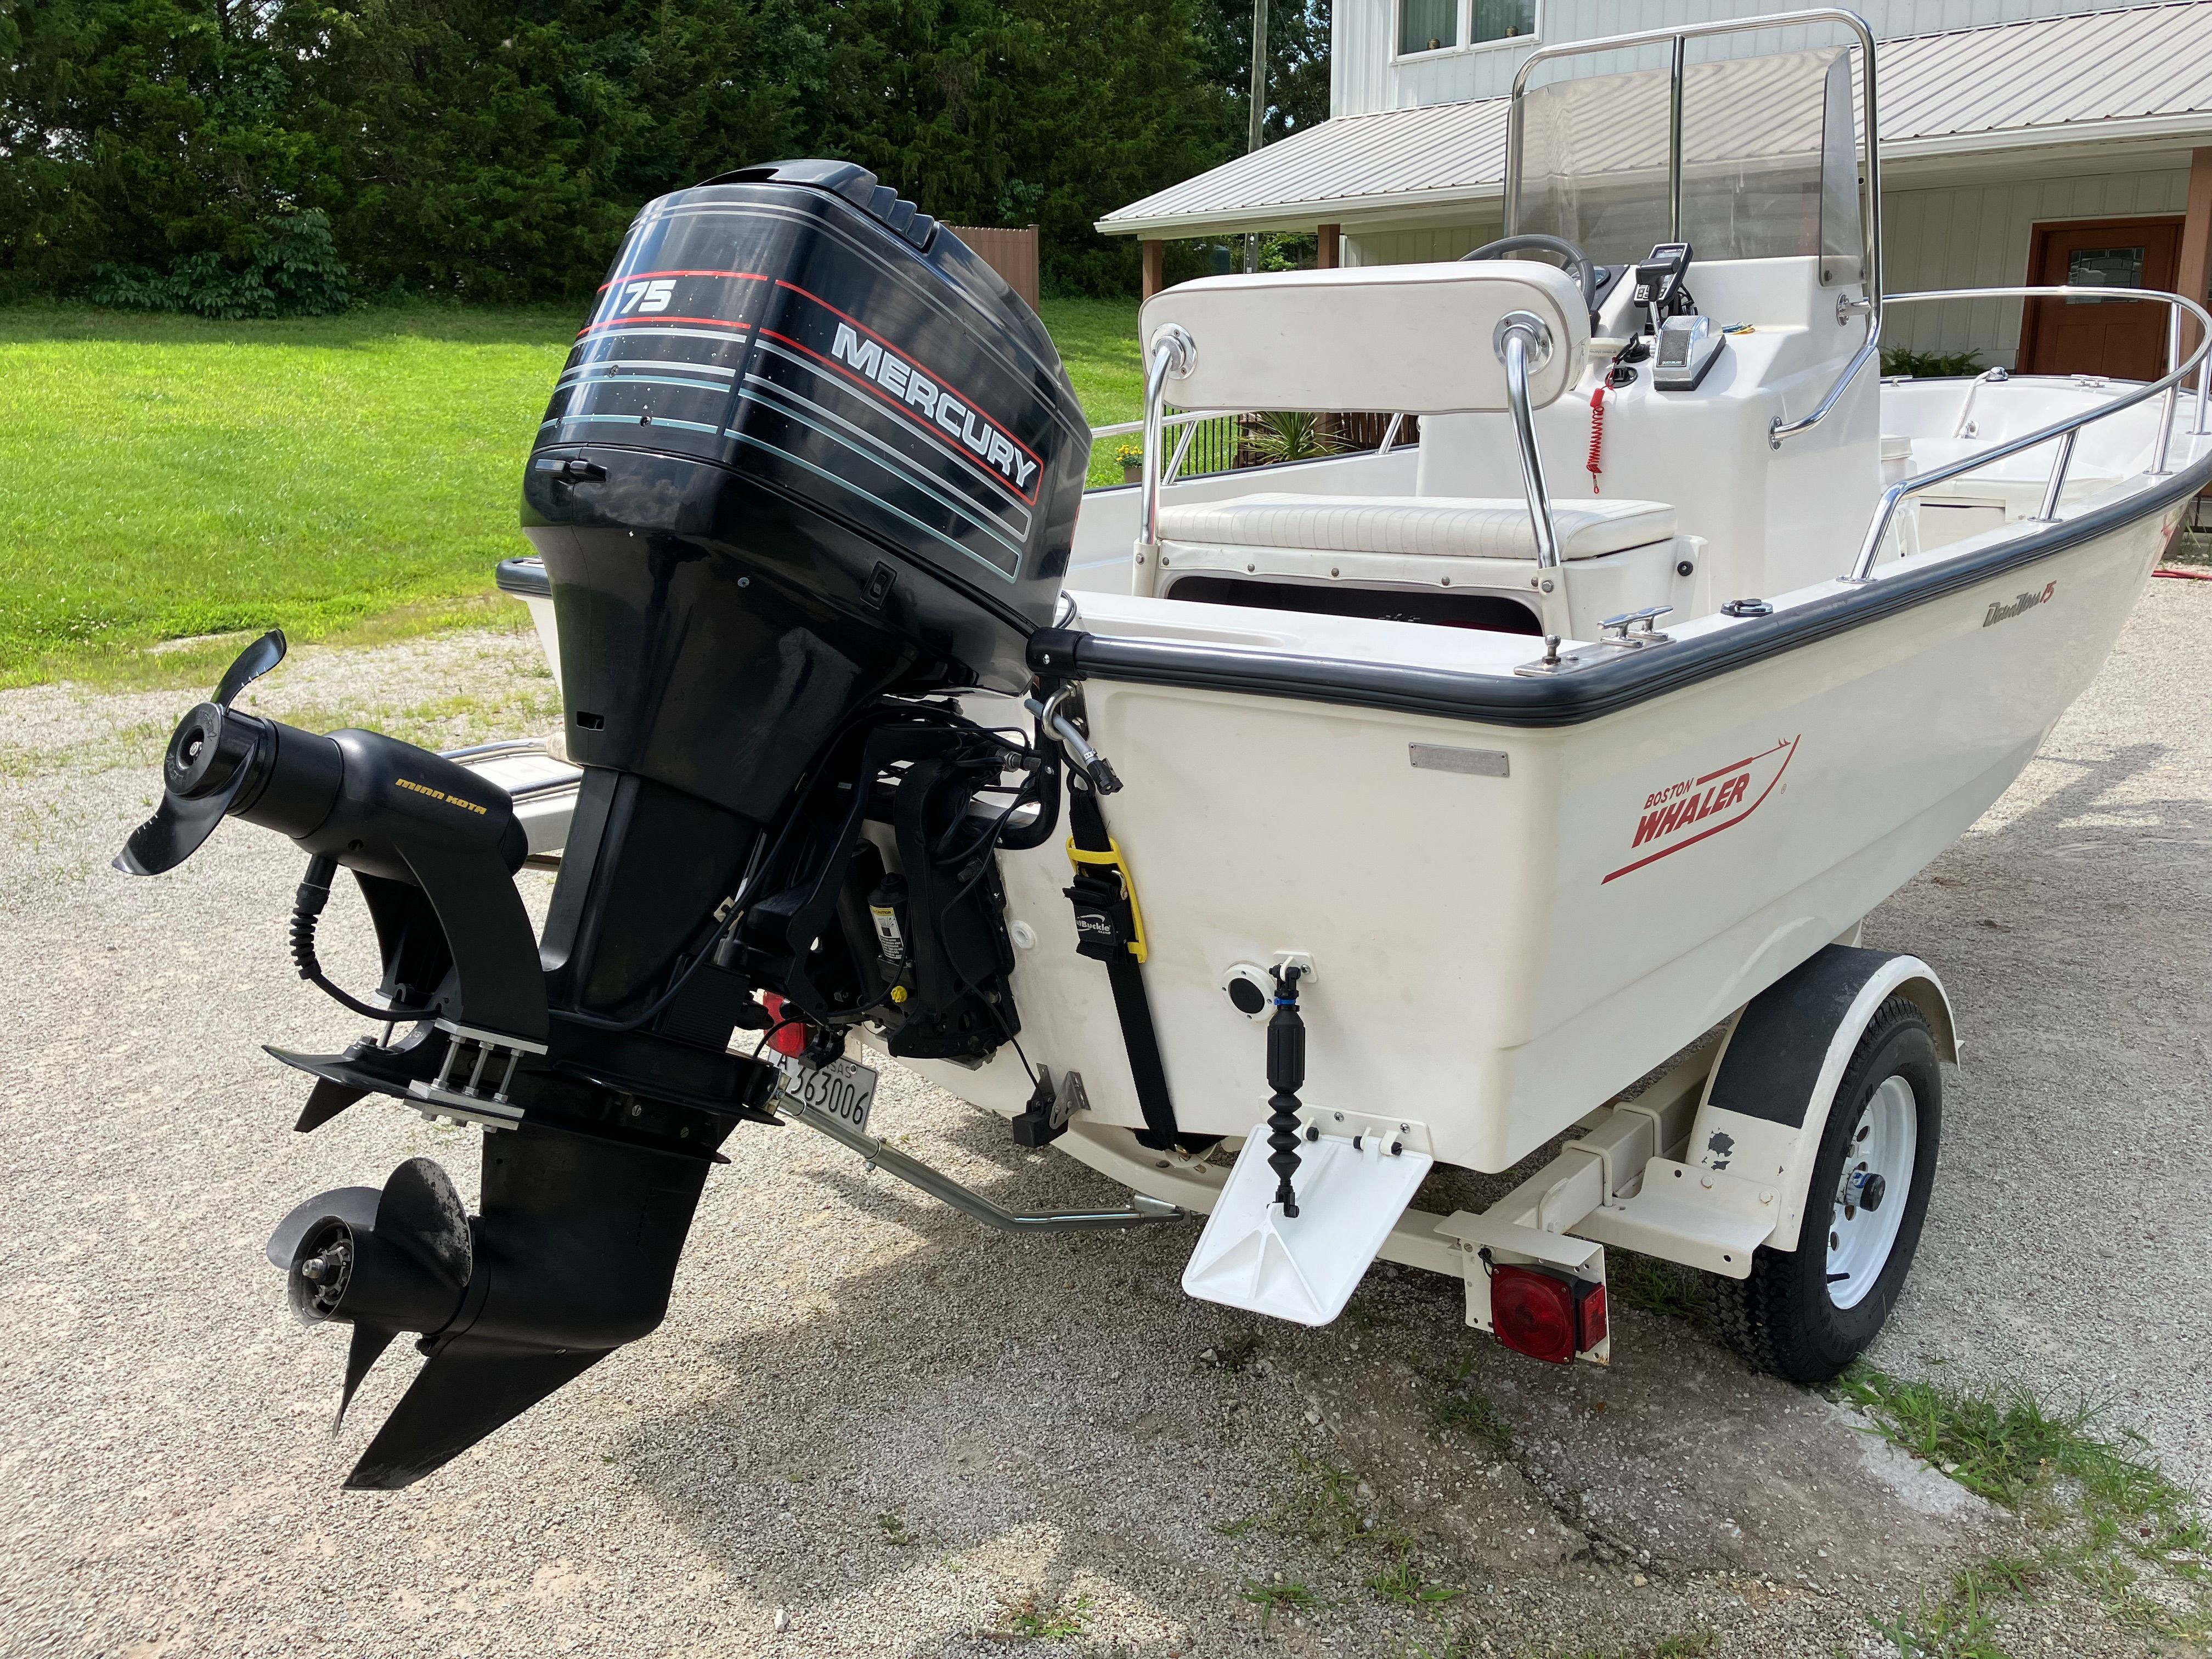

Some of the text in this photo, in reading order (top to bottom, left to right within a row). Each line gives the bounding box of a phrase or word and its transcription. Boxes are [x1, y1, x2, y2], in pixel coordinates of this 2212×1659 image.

[620, 279, 677, 314] 75
[831, 322, 1037, 488] MERCURY
[395, 777, 487, 815] MINN KOTA
[1631, 772, 1750, 849] WHALER
[1643, 777, 1695, 810] BOSTON
